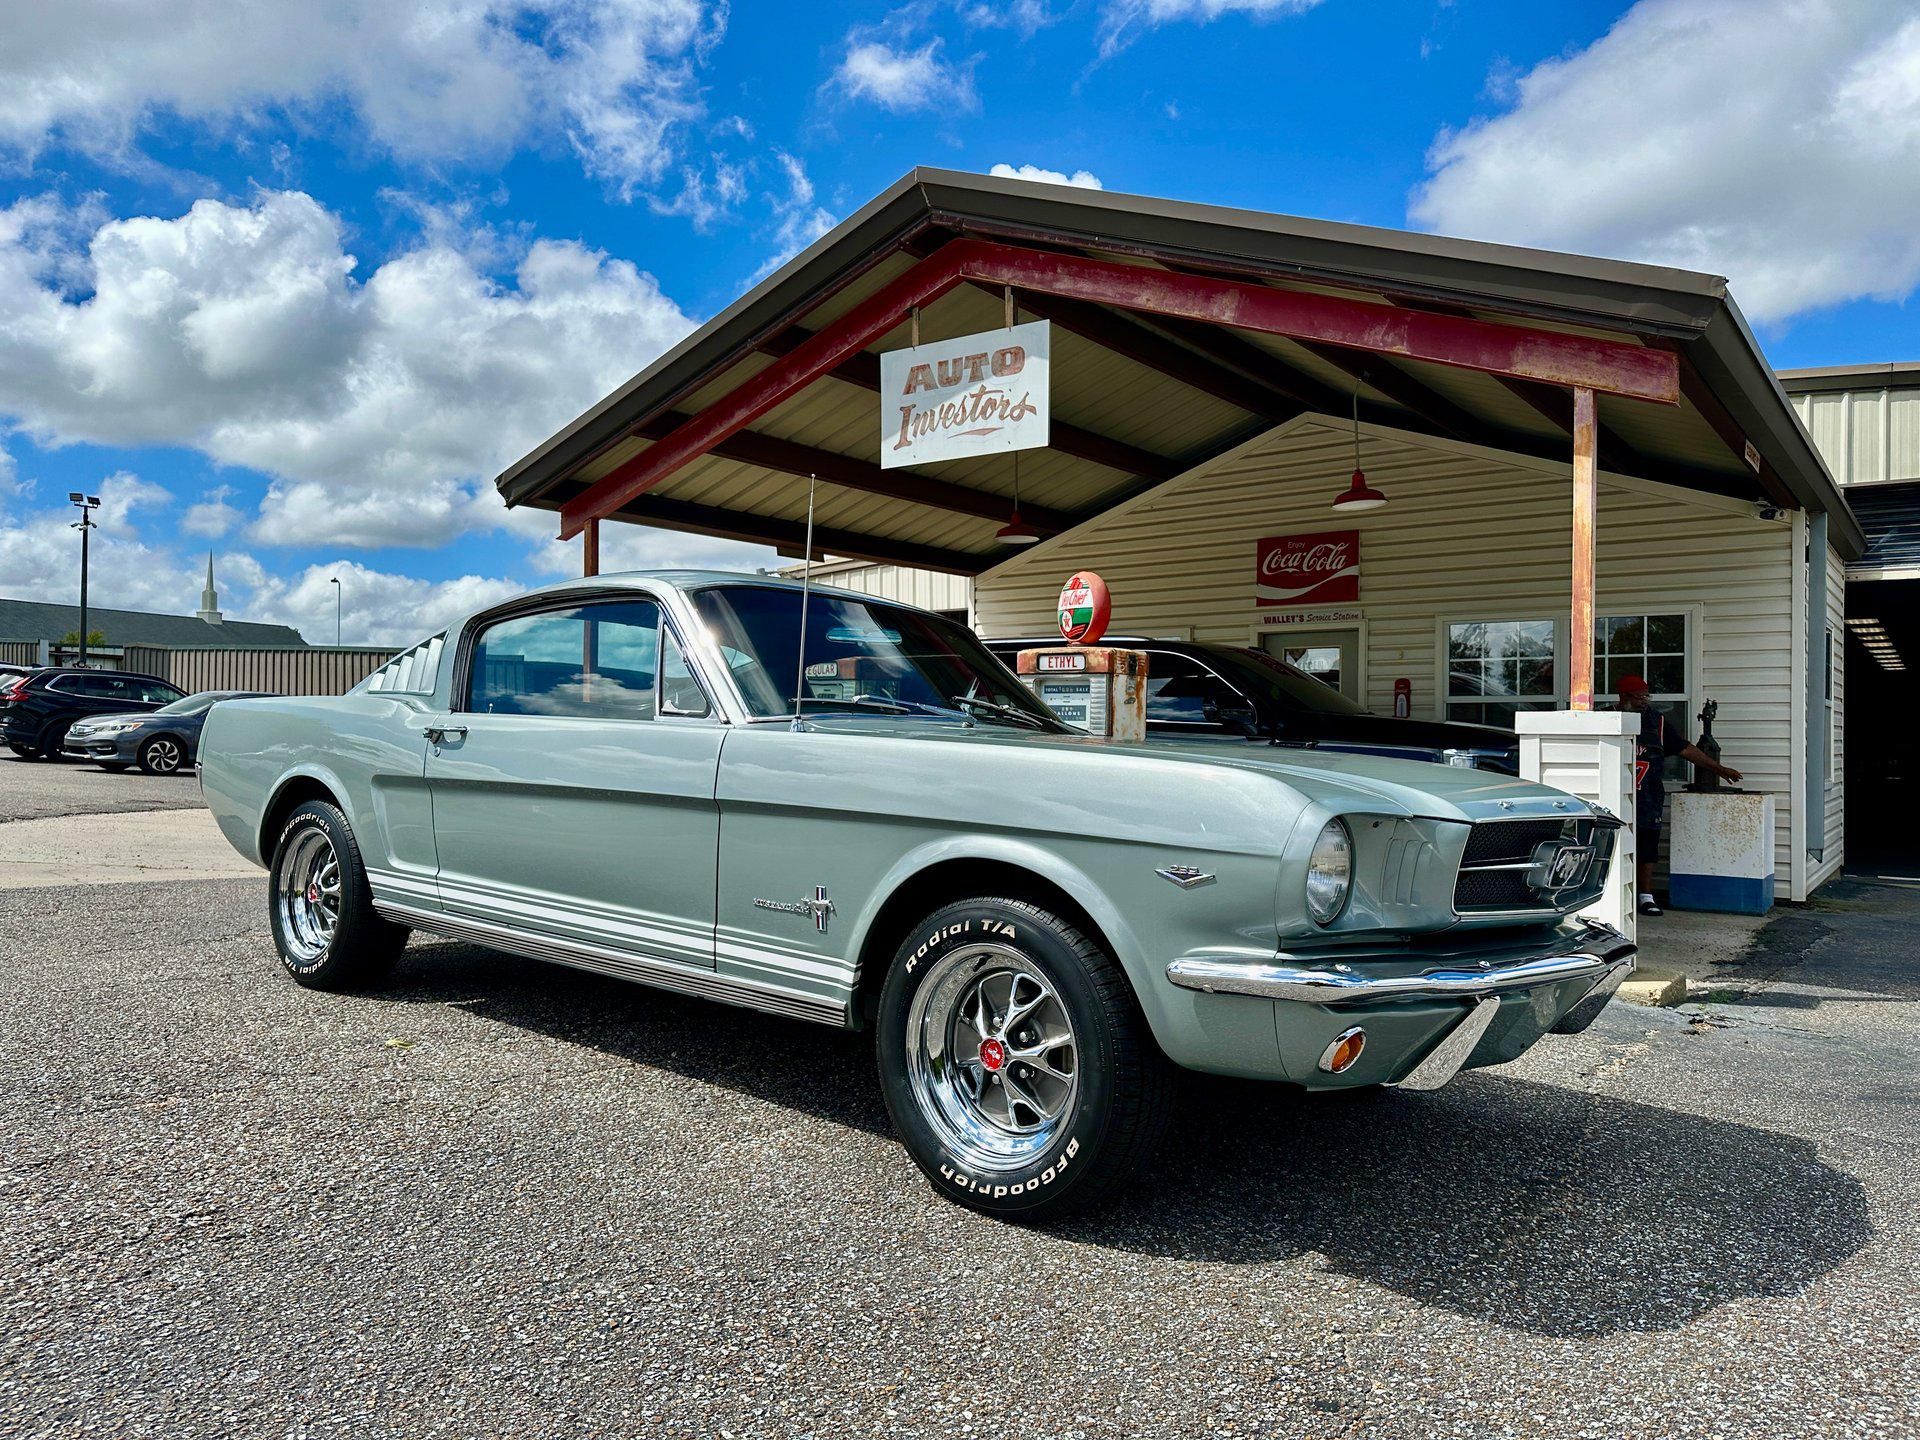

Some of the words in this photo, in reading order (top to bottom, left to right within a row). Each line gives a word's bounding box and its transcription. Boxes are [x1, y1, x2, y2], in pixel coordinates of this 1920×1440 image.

[903, 346, 1025, 395] AUTO
[893, 384, 1037, 450] Investors
[1306, 614, 1332, 622] Service
[1333, 612, 1359, 621] Station
[807, 664, 835, 675] EGULAR
[1048, 656, 1077, 668] ETHYL
[905, 919, 971, 974] Radial
[981, 918, 1016, 939] T/A
[940, 1136, 1080, 1199] BFGoodrich
